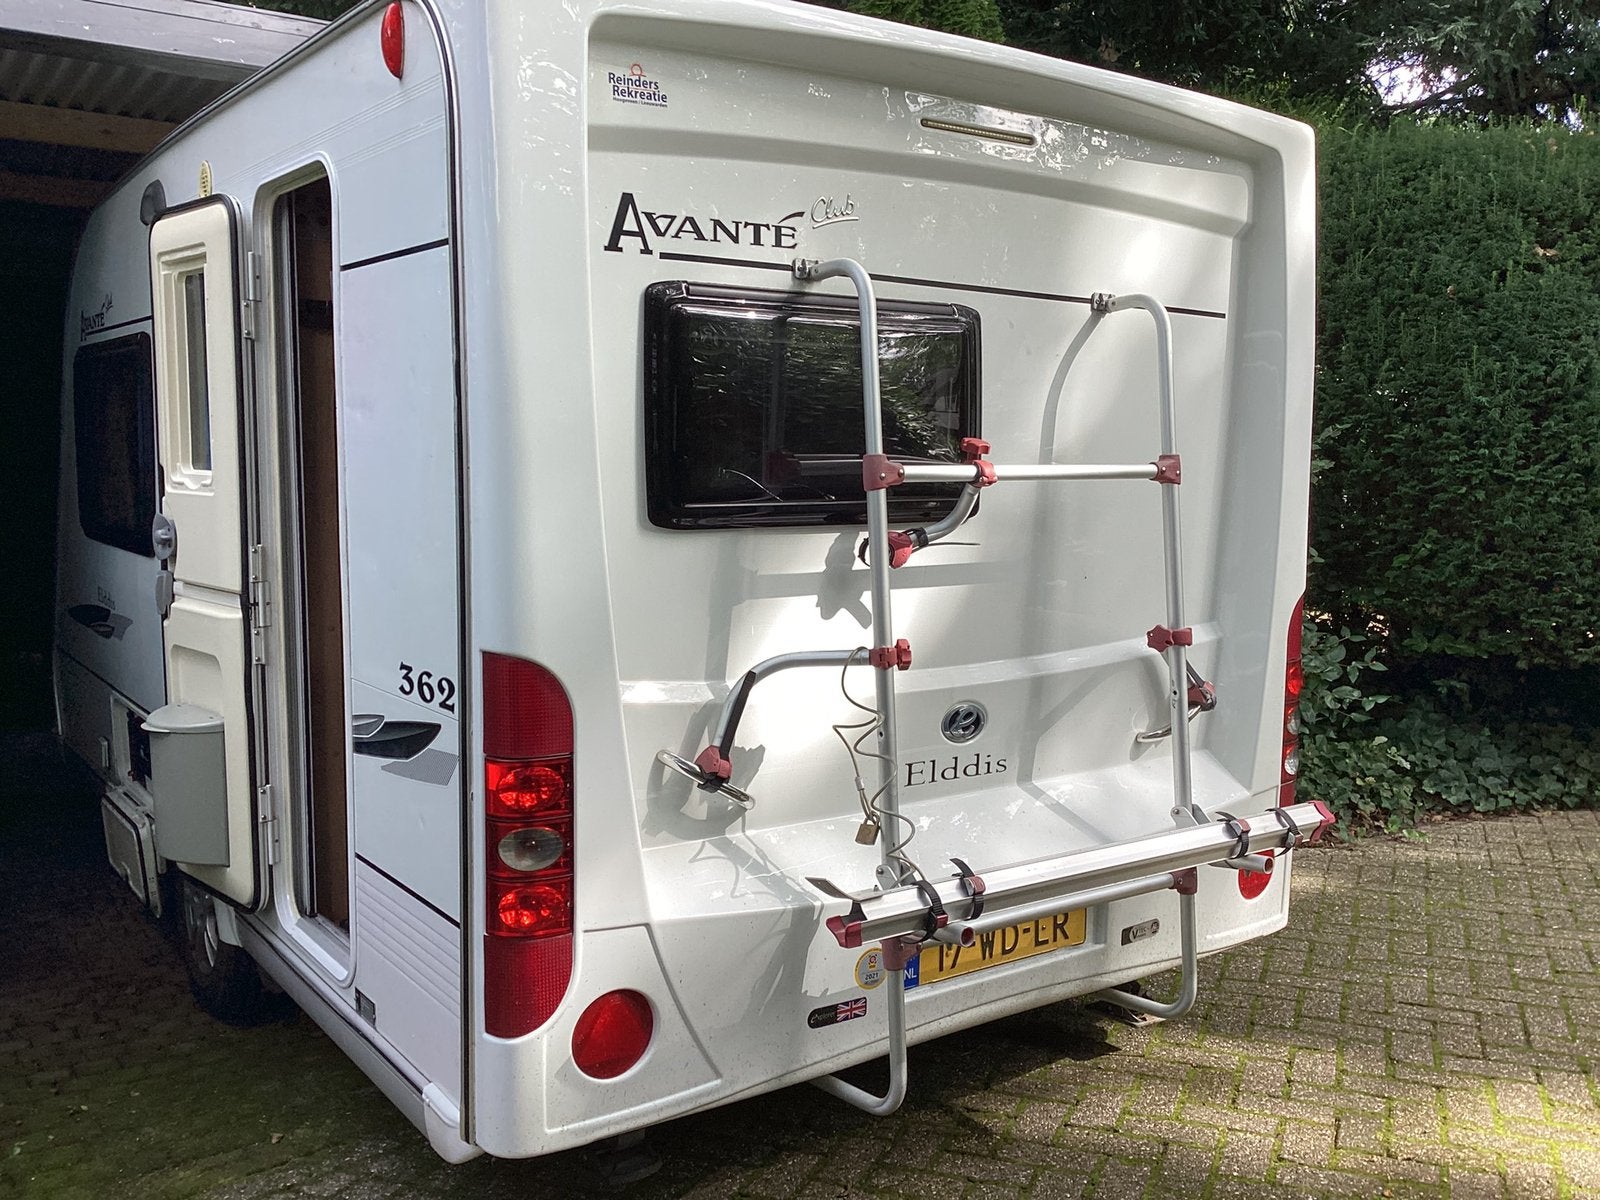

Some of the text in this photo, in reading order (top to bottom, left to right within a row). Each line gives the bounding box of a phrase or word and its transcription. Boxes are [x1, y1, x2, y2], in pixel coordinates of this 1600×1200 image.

[608, 72, 659, 90] Reinders
[612, 85, 668, 103] Rekreatie
[811, 193, 855, 223] Club
[398, 661, 456, 714] 362
[903, 753, 1008, 788] Elddis
[865, 972, 879, 981] 2021
[904, 968, 917, 980] NL
